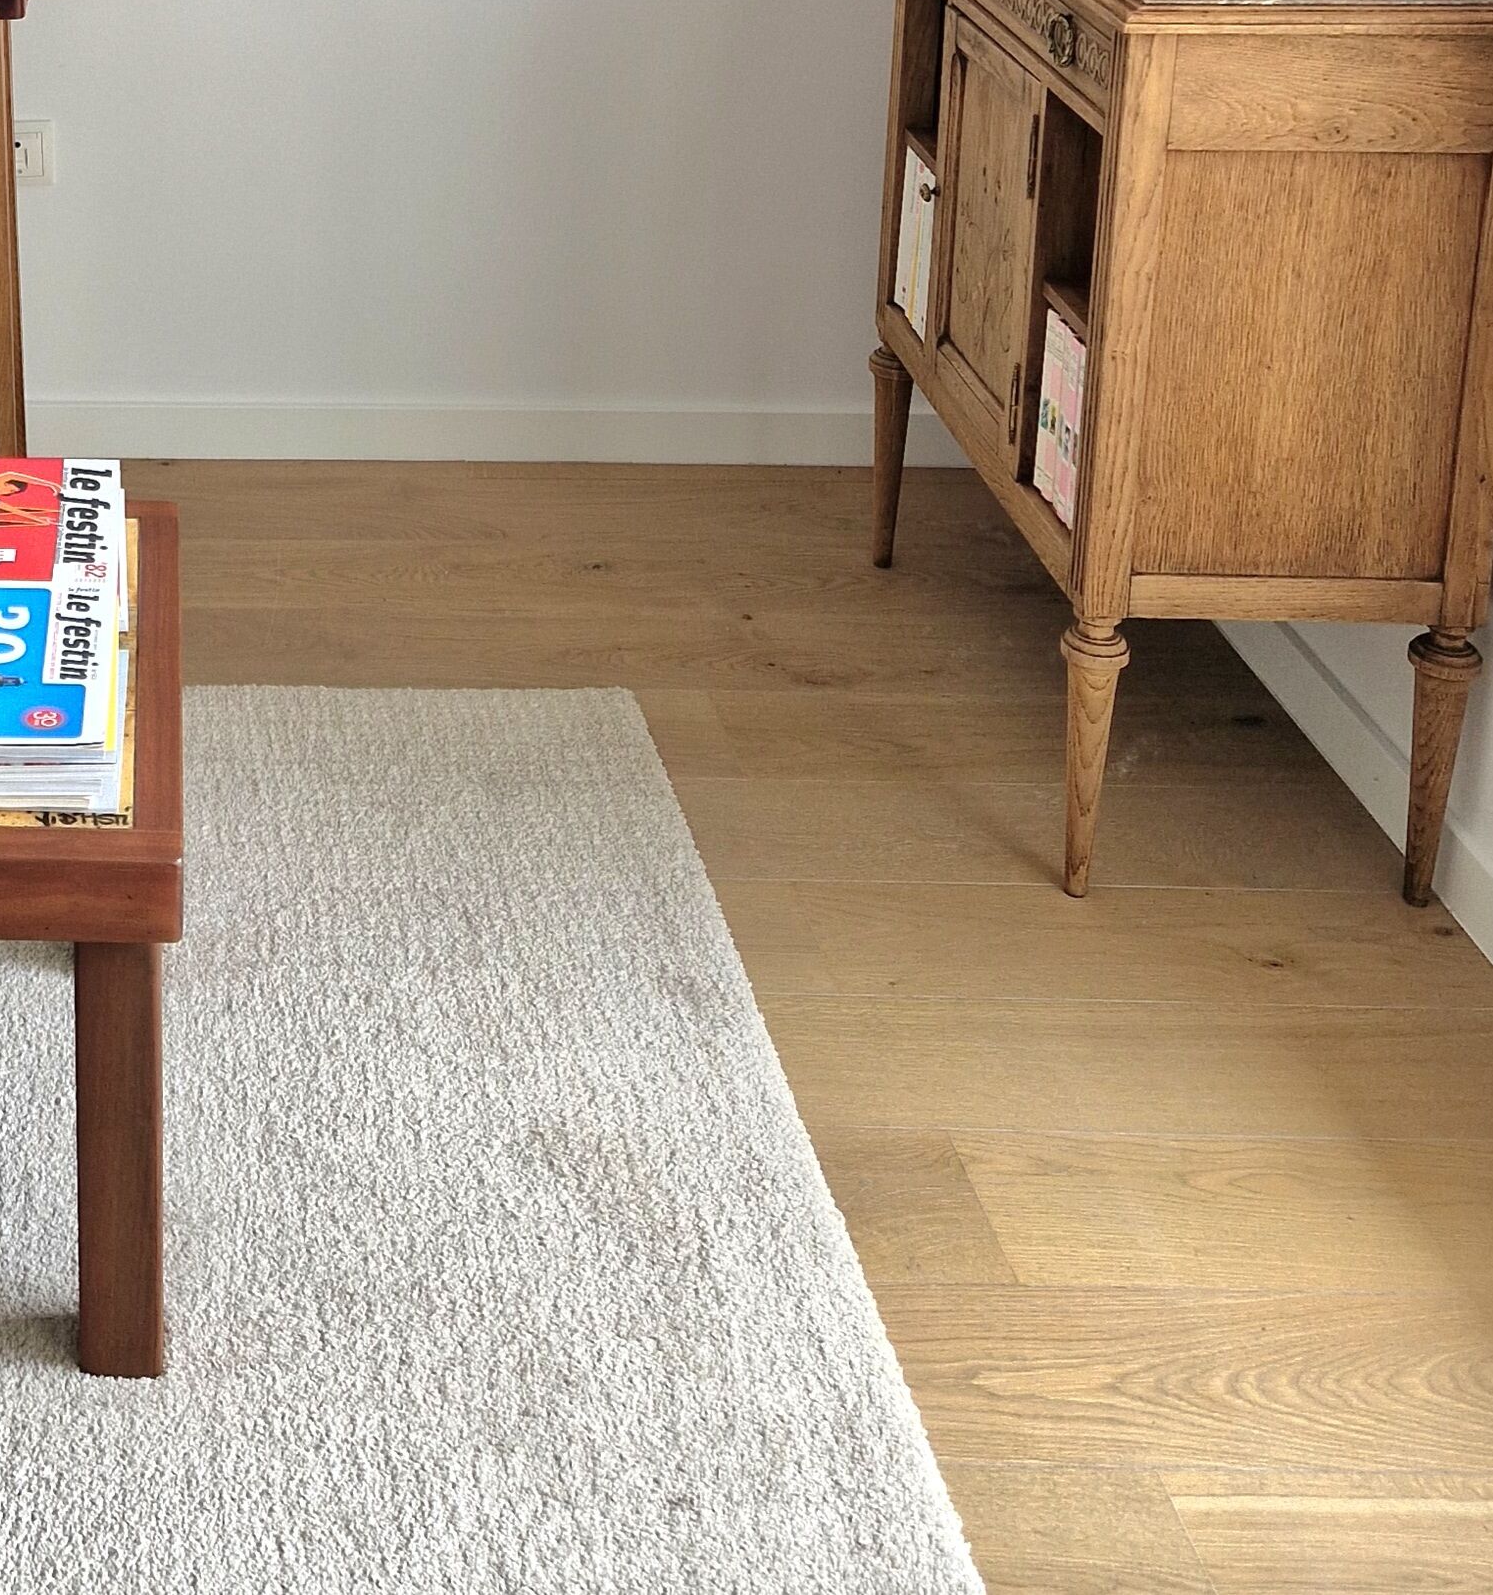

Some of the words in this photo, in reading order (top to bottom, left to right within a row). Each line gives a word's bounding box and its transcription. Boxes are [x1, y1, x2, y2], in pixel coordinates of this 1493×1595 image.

[69, 467, 112, 491] le
[59, 493, 111, 564] festin
[66, 593, 100, 612] le
[54, 612, 102, 680] festin
[33, 710, 58, 727] 30
